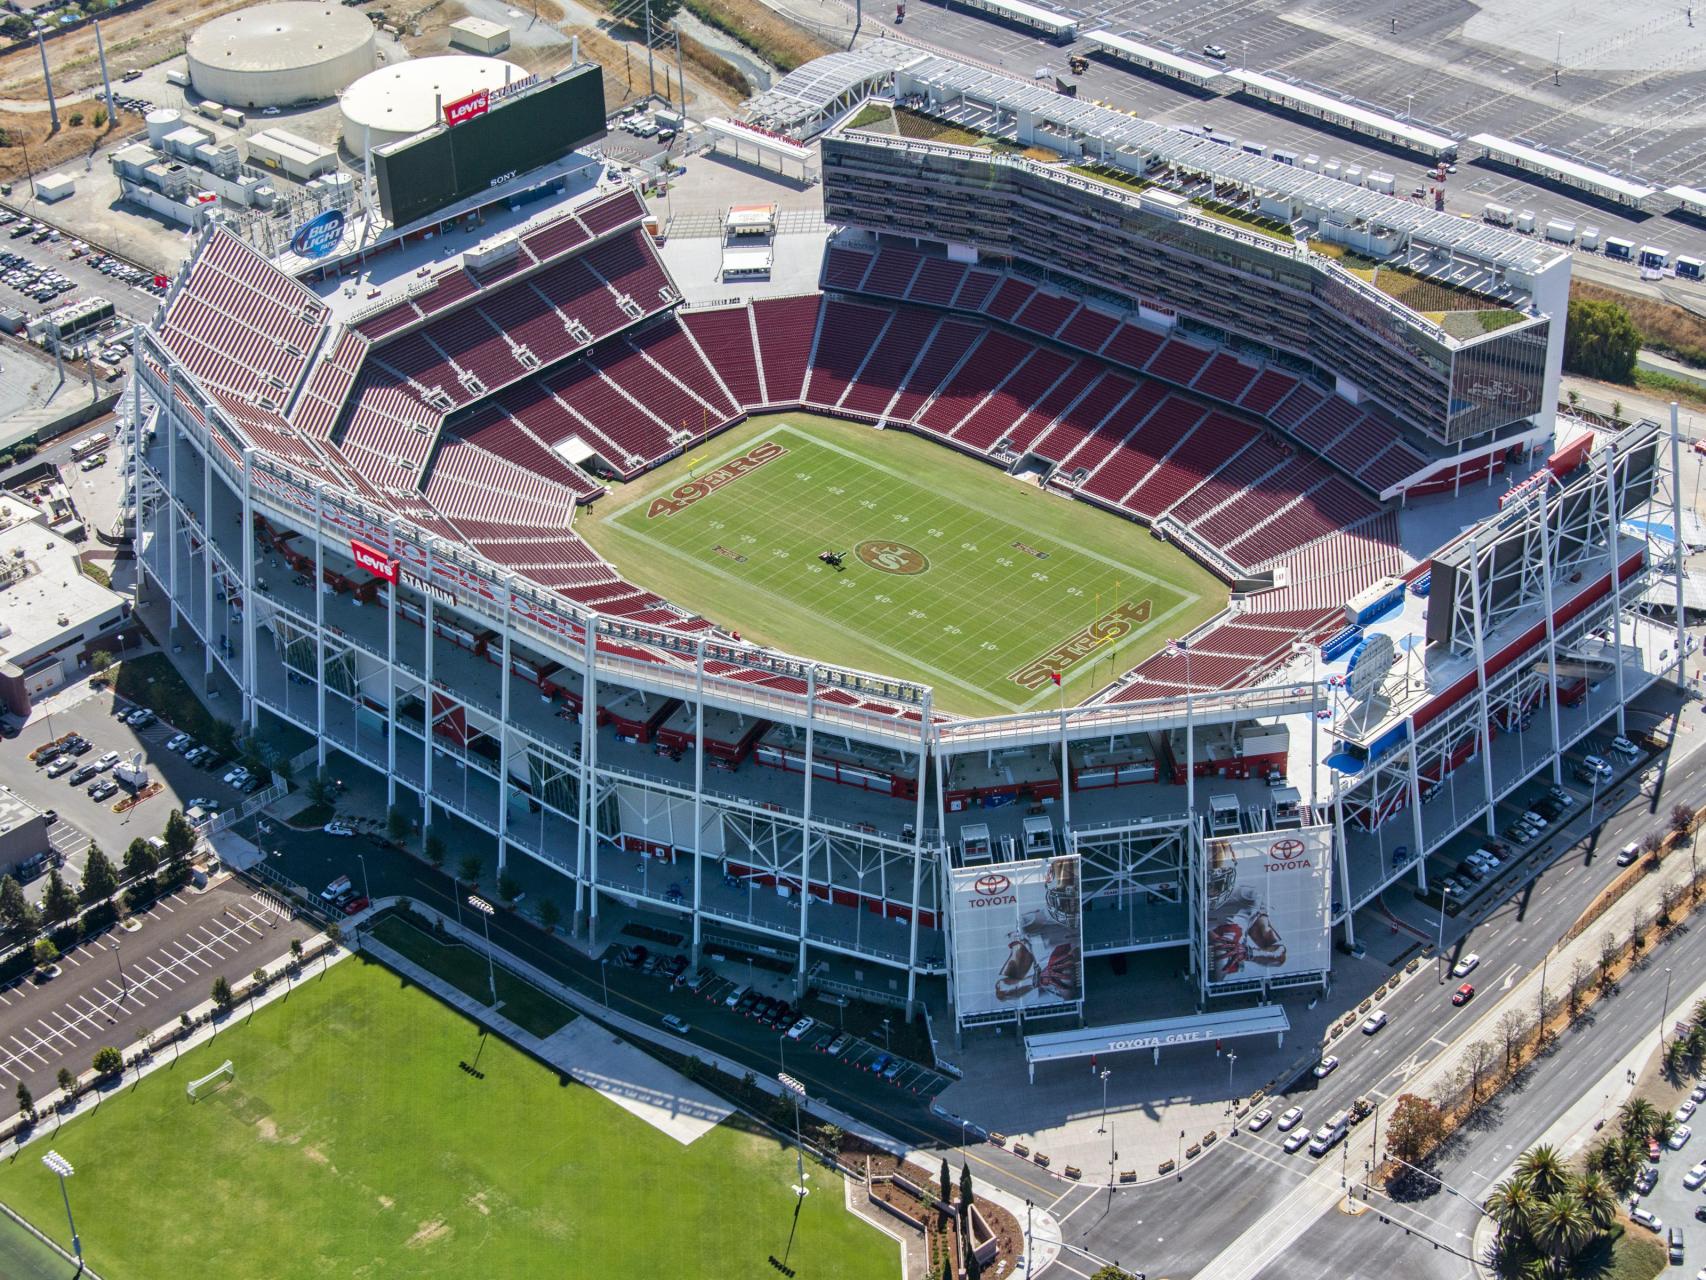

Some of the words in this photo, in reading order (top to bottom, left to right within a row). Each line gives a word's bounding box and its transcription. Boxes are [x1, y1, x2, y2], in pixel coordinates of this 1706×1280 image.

[451, 97, 486, 119] Levi's
[490, 74, 540, 100] STADIUM
[490, 170, 517, 187] SONY
[302, 226, 344, 251] LIGHT
[308, 219, 339, 239] BUD
[647, 441, 791, 519] 49ERS
[355, 550, 394, 577] Levi's
[400, 570, 456, 607] STADIUM
[1006, 599, 1153, 691] 49ERS
[1264, 859, 1311, 873] TOYOTA
[968, 895, 1017, 908] TOYOTA
[1108, 1037, 1160, 1050] TOYOTA
[1167, 1031, 1200, 1044] GATE
[1205, 1030, 1213, 1040] F
